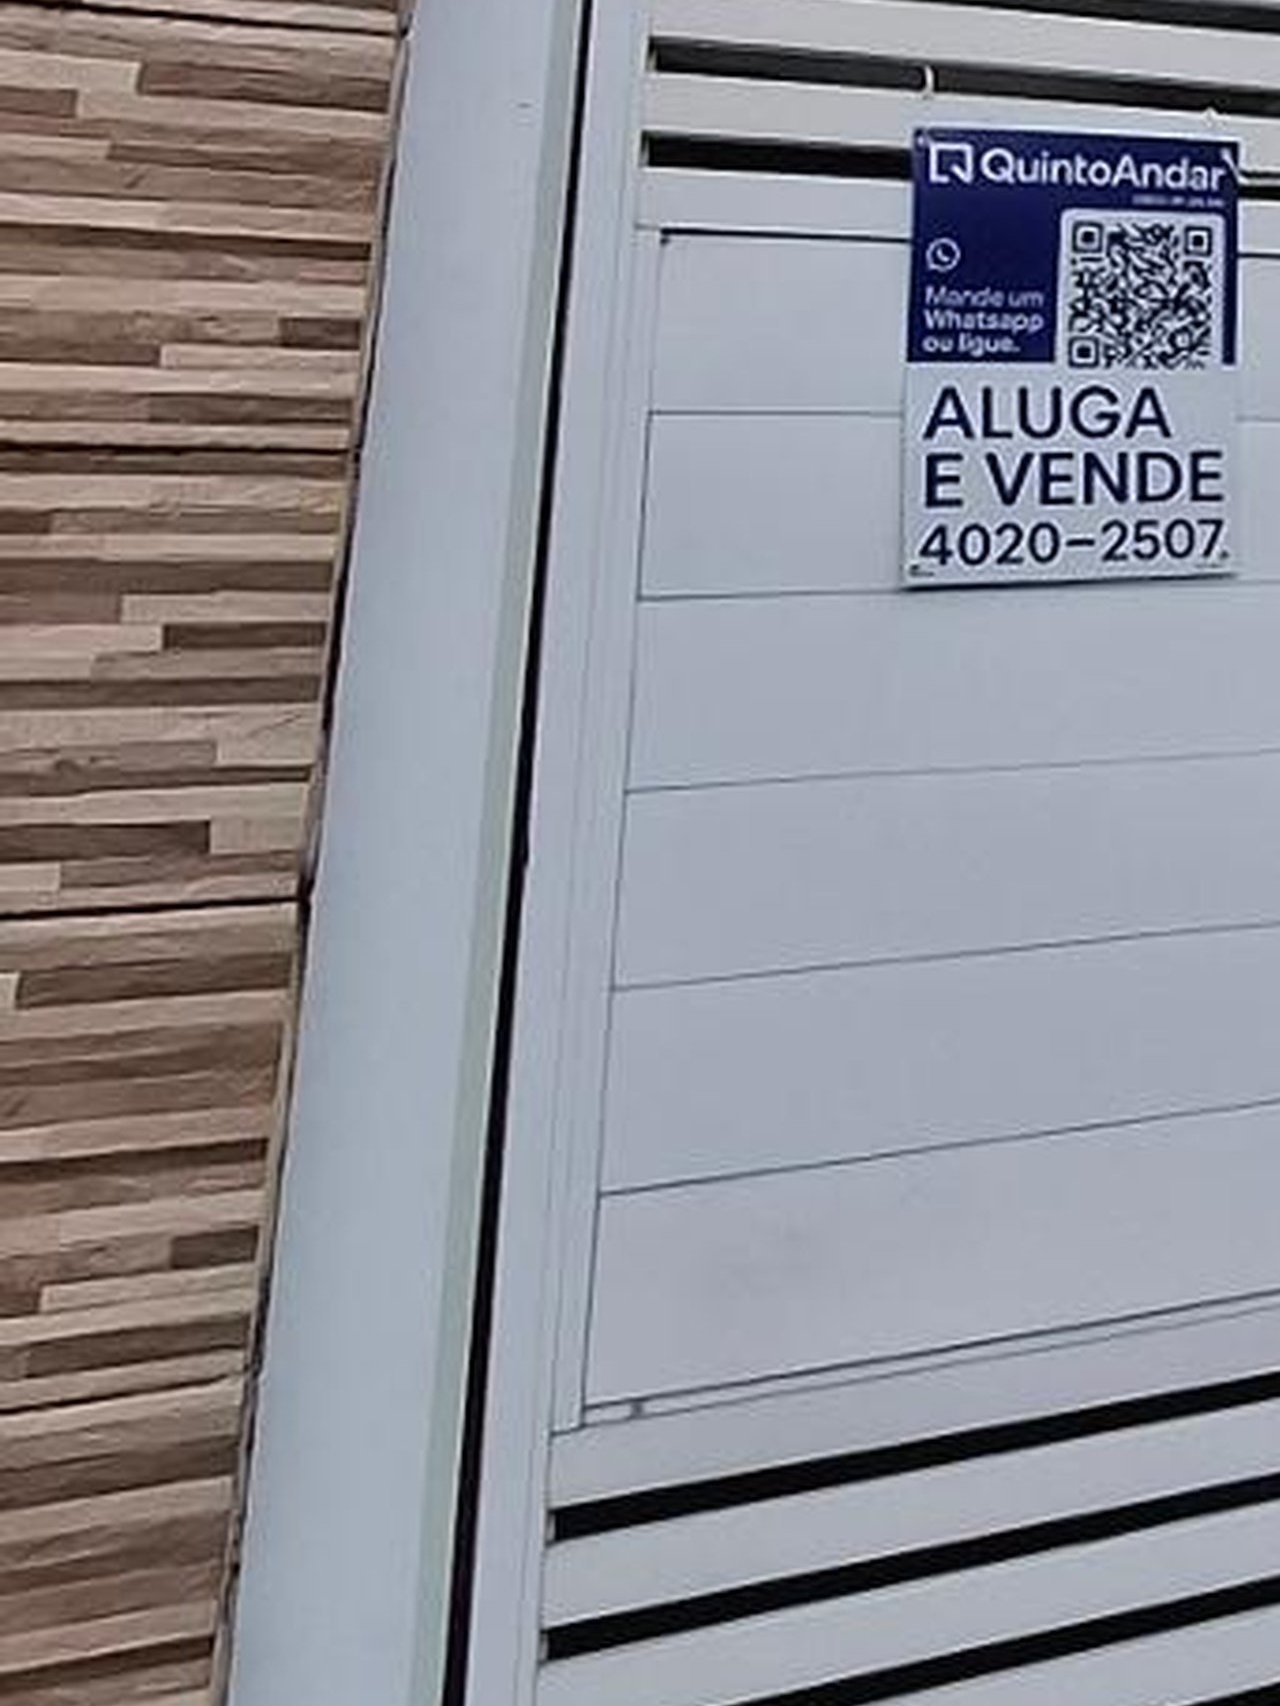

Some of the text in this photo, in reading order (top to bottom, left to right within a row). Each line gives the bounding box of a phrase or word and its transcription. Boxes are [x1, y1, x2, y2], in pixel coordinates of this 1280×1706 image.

[980, 147, 1226, 192] QuintoAndar
[924, 285, 1045, 307] Mande um
[921, 331, 1022, 357] ou ligue.
[922, 308, 1045, 335] Whatsapp
[922, 386, 1172, 440] ALUGA
[925, 449, 1225, 508] E VENDE
[918, 518, 1225, 566] 4020-2507
